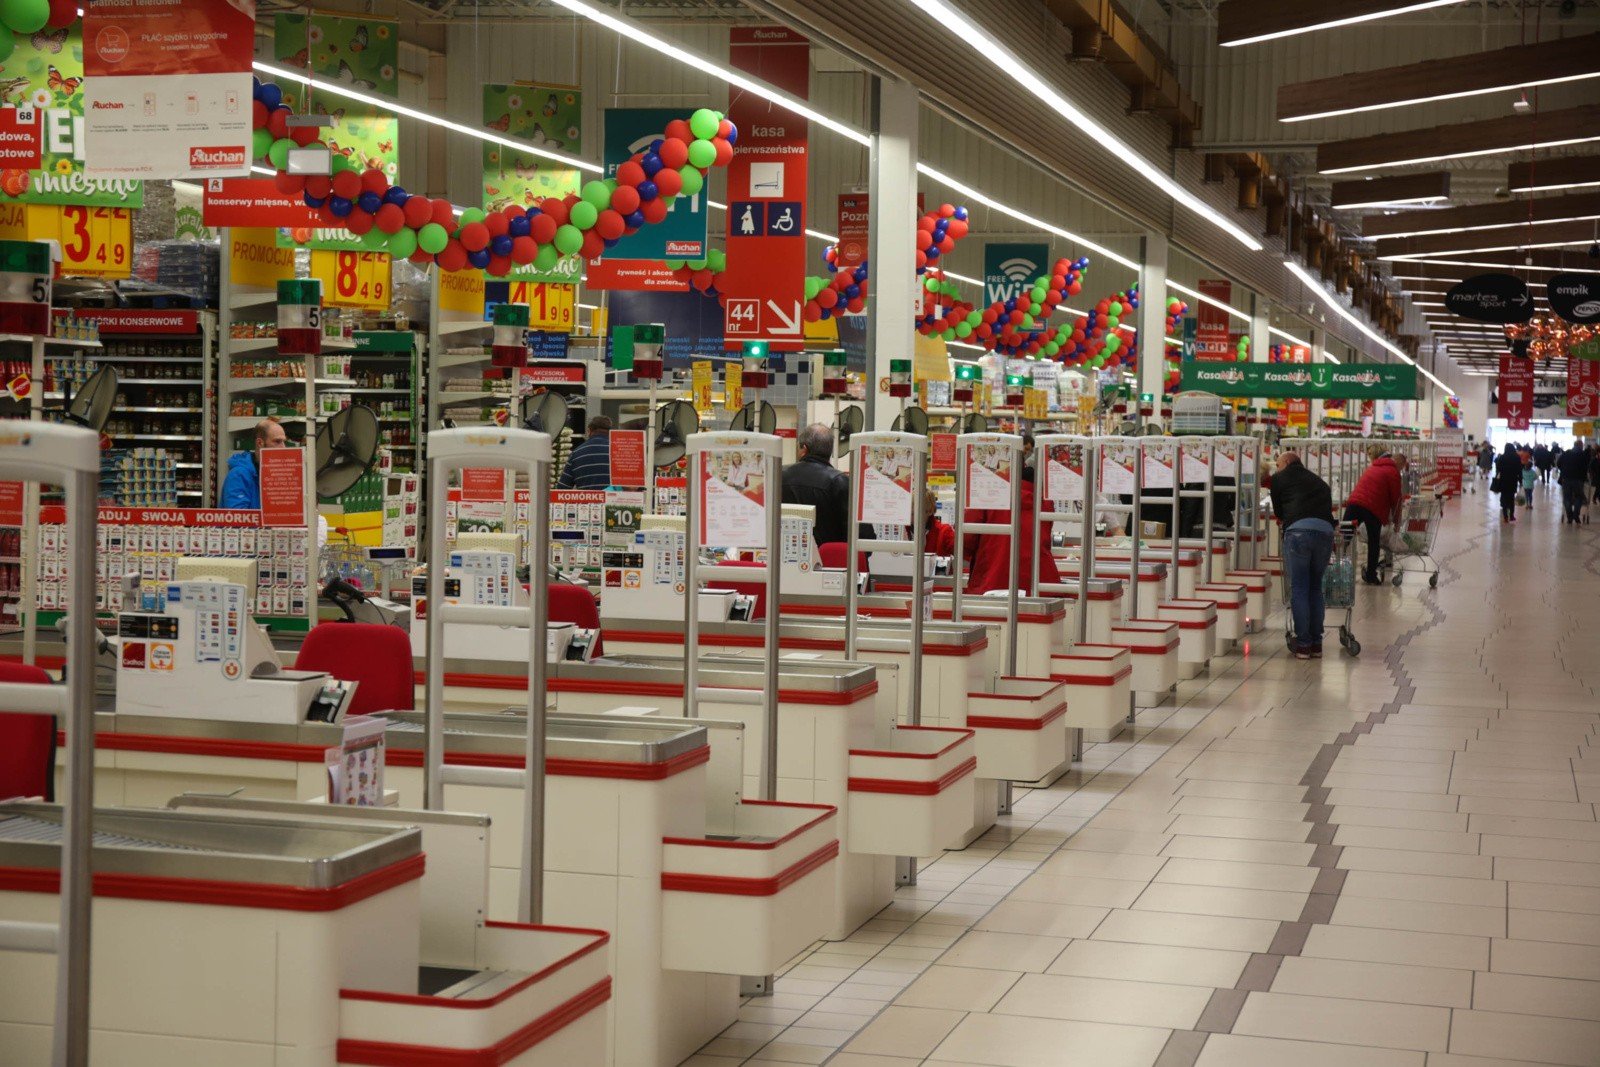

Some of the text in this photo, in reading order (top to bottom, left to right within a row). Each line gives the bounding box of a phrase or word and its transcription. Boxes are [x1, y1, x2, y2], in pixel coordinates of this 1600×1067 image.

[92, 101, 124, 109] Auchan
[19, 112, 33, 120] 68
[752, 125, 786, 137] kasa
[733, 145, 805, 155] pierwszeństwa
[191, 148, 244, 163] Auchan
[208, 198, 252, 207] konserwy
[255, 198, 291, 207] mięsne,
[64, 206, 91, 263] 3
[668, 242, 700, 251] Auchan
[233, 241, 294, 265] PROMOCJA
[337, 250, 358, 297] 8
[441, 274, 484, 294] PROMOCJA
[1556, 284, 1589, 295] empik
[1452, 293, 1498, 301] martes
[1480, 300, 1506, 308] sport
[1578, 304, 1600, 312] PEPCO
[730, 304, 755, 320] 44
[119, 317, 183, 326] KONSERWOWE
[728, 322, 741, 331] nr
[1200, 322, 1225, 330] kasa
[760, 359, 768, 370] 4
[557, 492, 605, 502] KOMÓRKĘ
[141, 511, 185, 523] SWOJĄ
[196, 511, 259, 525] KOMÓRKĘ
[613, 510, 633, 526] 10
